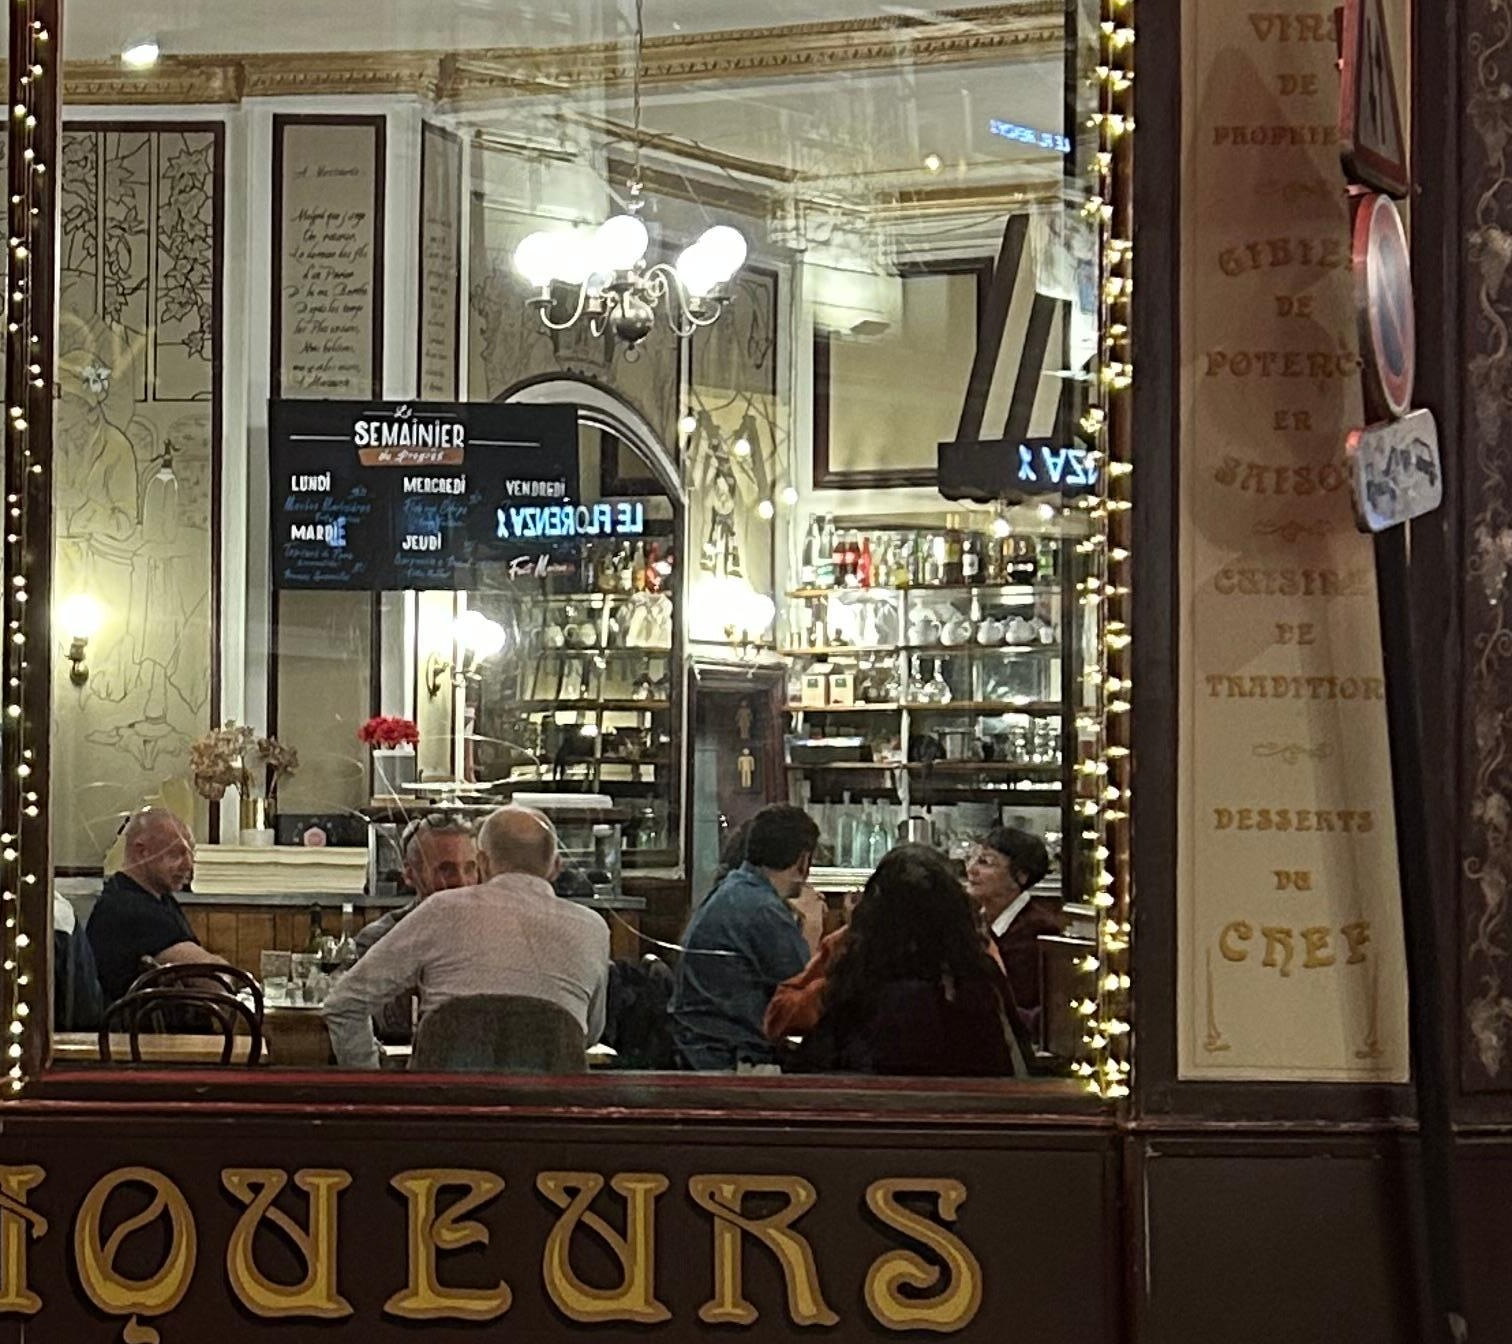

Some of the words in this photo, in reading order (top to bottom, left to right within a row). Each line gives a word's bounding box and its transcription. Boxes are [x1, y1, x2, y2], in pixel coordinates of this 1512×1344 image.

[1277, 73, 1318, 97] DE
[1219, 238, 1354, 277] GIBIE
[1275, 294, 1313, 318] DE
[291, 471, 331, 492] LUNDI
[1214, 456, 1348, 496] SAISO
[402, 531, 442, 551] JEUDI
[1274, 622, 1315, 645] DE
[1213, 808, 1374, 832] DESSERTS
[1273, 870, 1313, 891] DU
[1219, 919, 1371, 977] CHEF
